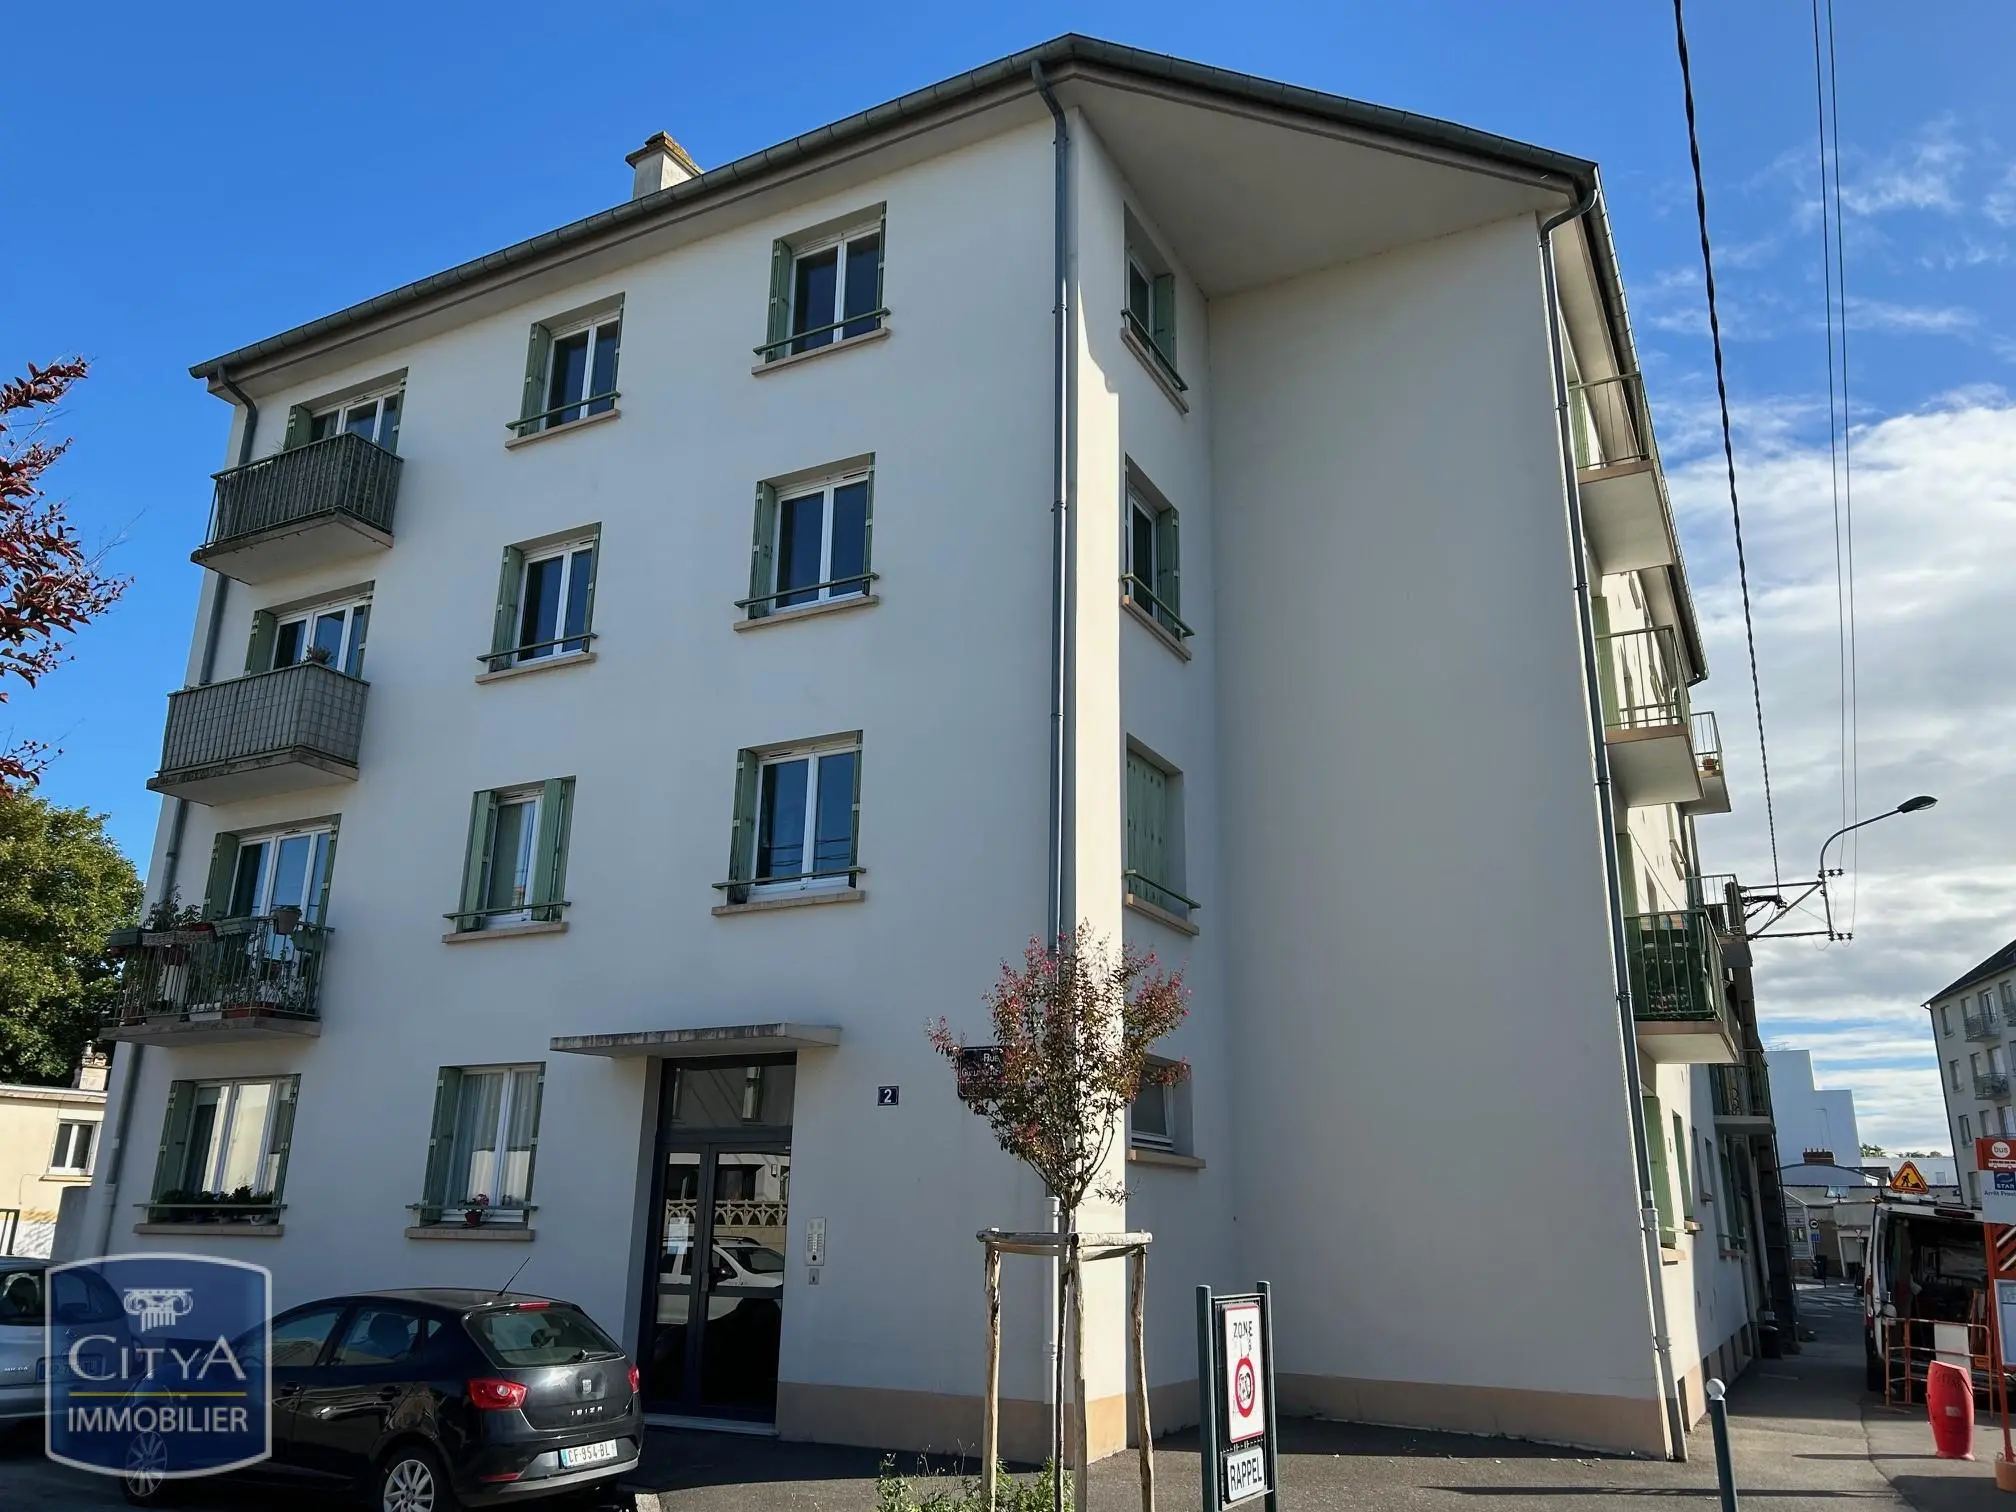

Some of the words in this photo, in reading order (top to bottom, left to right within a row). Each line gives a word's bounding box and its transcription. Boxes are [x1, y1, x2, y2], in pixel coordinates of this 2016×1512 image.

[884, 1089, 893, 1103] 2
[1993, 1145, 2009, 1153] bus
[1233, 1320, 1253, 1338] ZONE
[571, 1405, 603, 1416] IBIZA
[1229, 1456, 1263, 1492] RAPPEL
